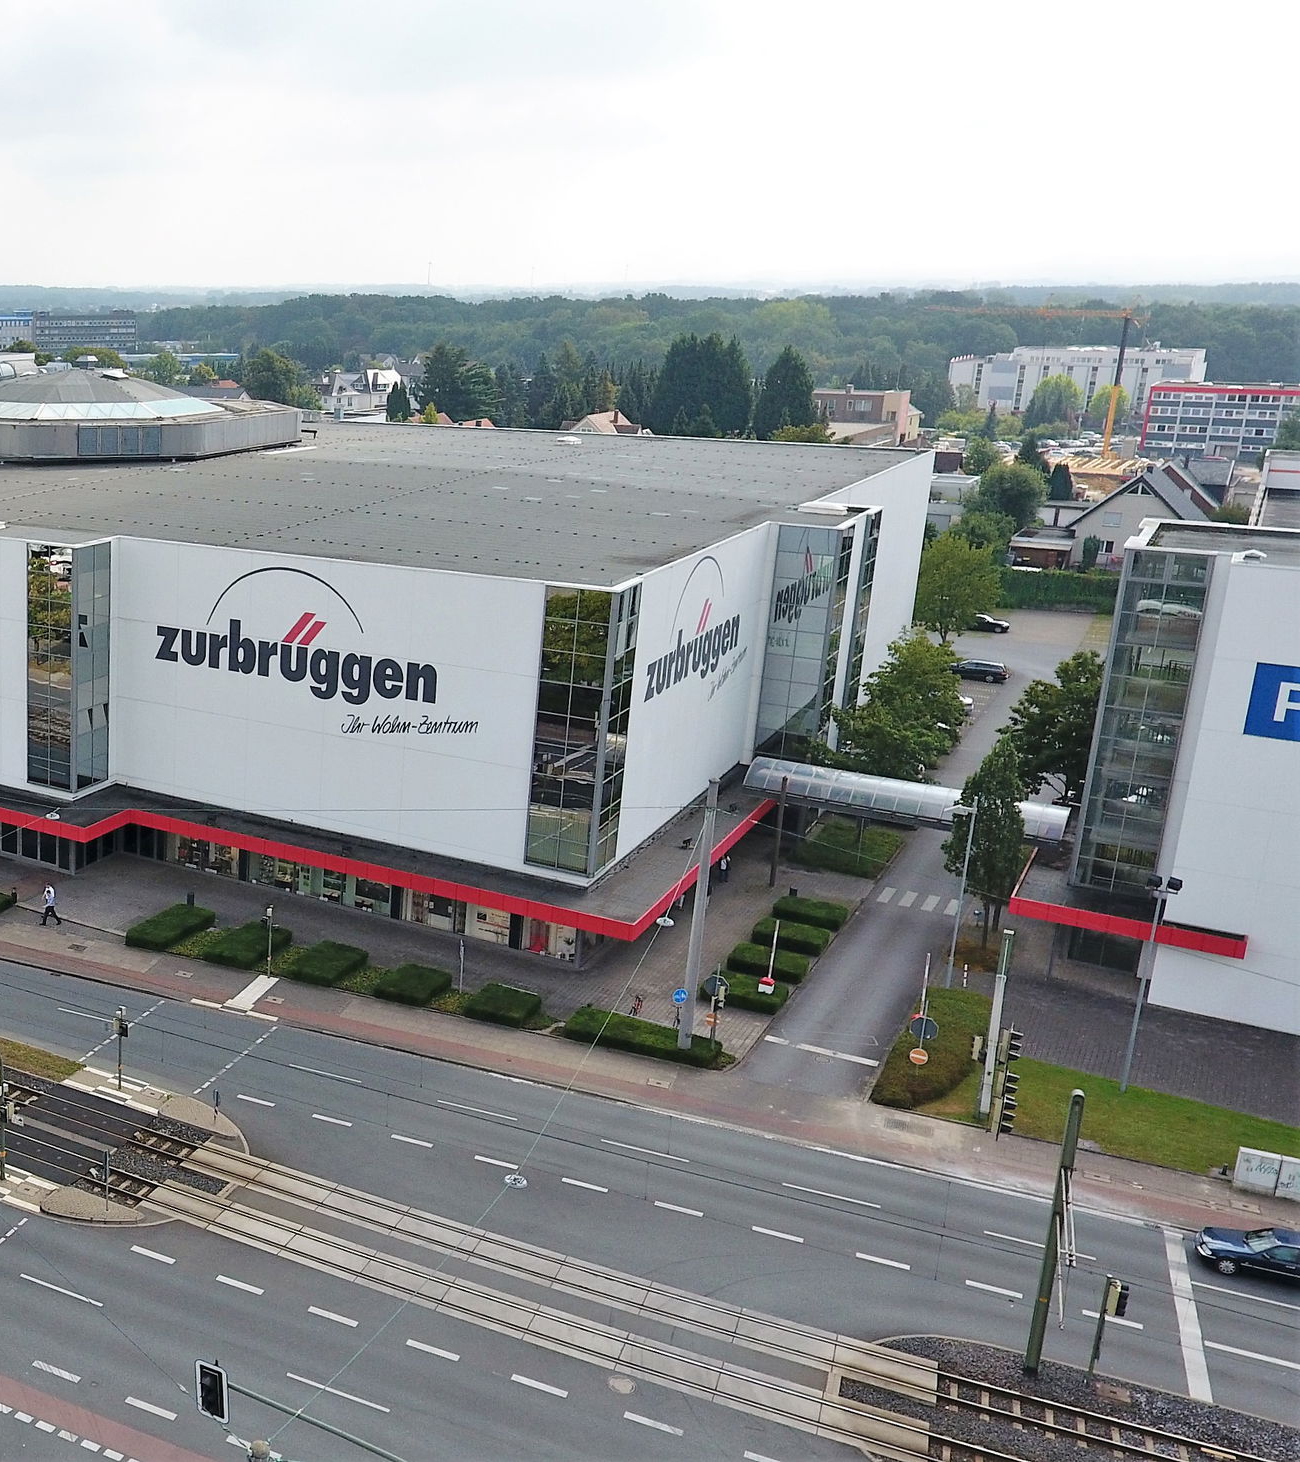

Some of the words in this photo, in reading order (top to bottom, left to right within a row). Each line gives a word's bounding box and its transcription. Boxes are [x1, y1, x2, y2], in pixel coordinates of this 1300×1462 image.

[155, 612, 437, 705] zurbrüggen
[644, 598, 740, 703] zurbrüggen
[341, 714, 369, 734] Ihr
[372, 714, 478, 734] Wohn-Zentrum
